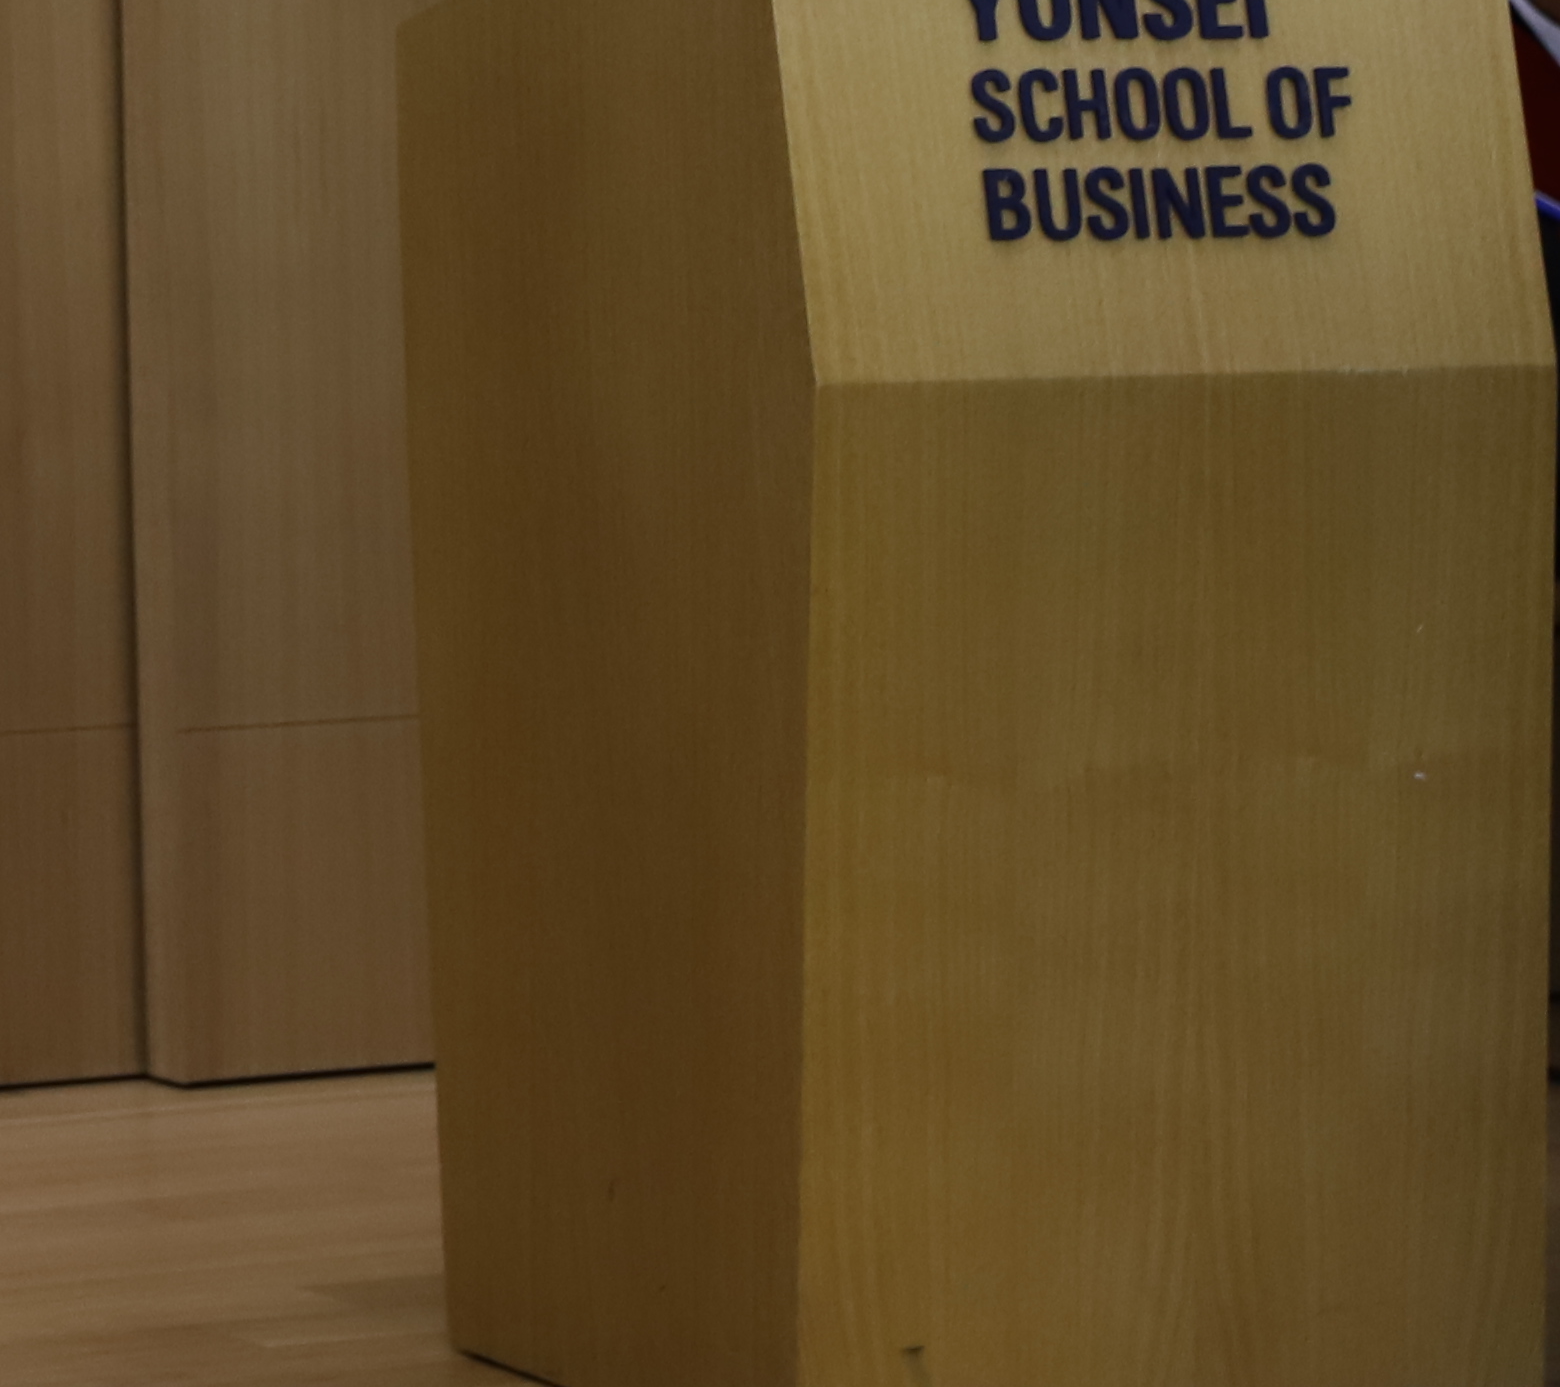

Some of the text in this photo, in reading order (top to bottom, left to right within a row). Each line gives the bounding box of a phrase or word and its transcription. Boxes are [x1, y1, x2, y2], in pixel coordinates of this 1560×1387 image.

[970, 66, 1352, 145] SCHOOL OF
[981, 163, 1336, 243] BUSINESS
